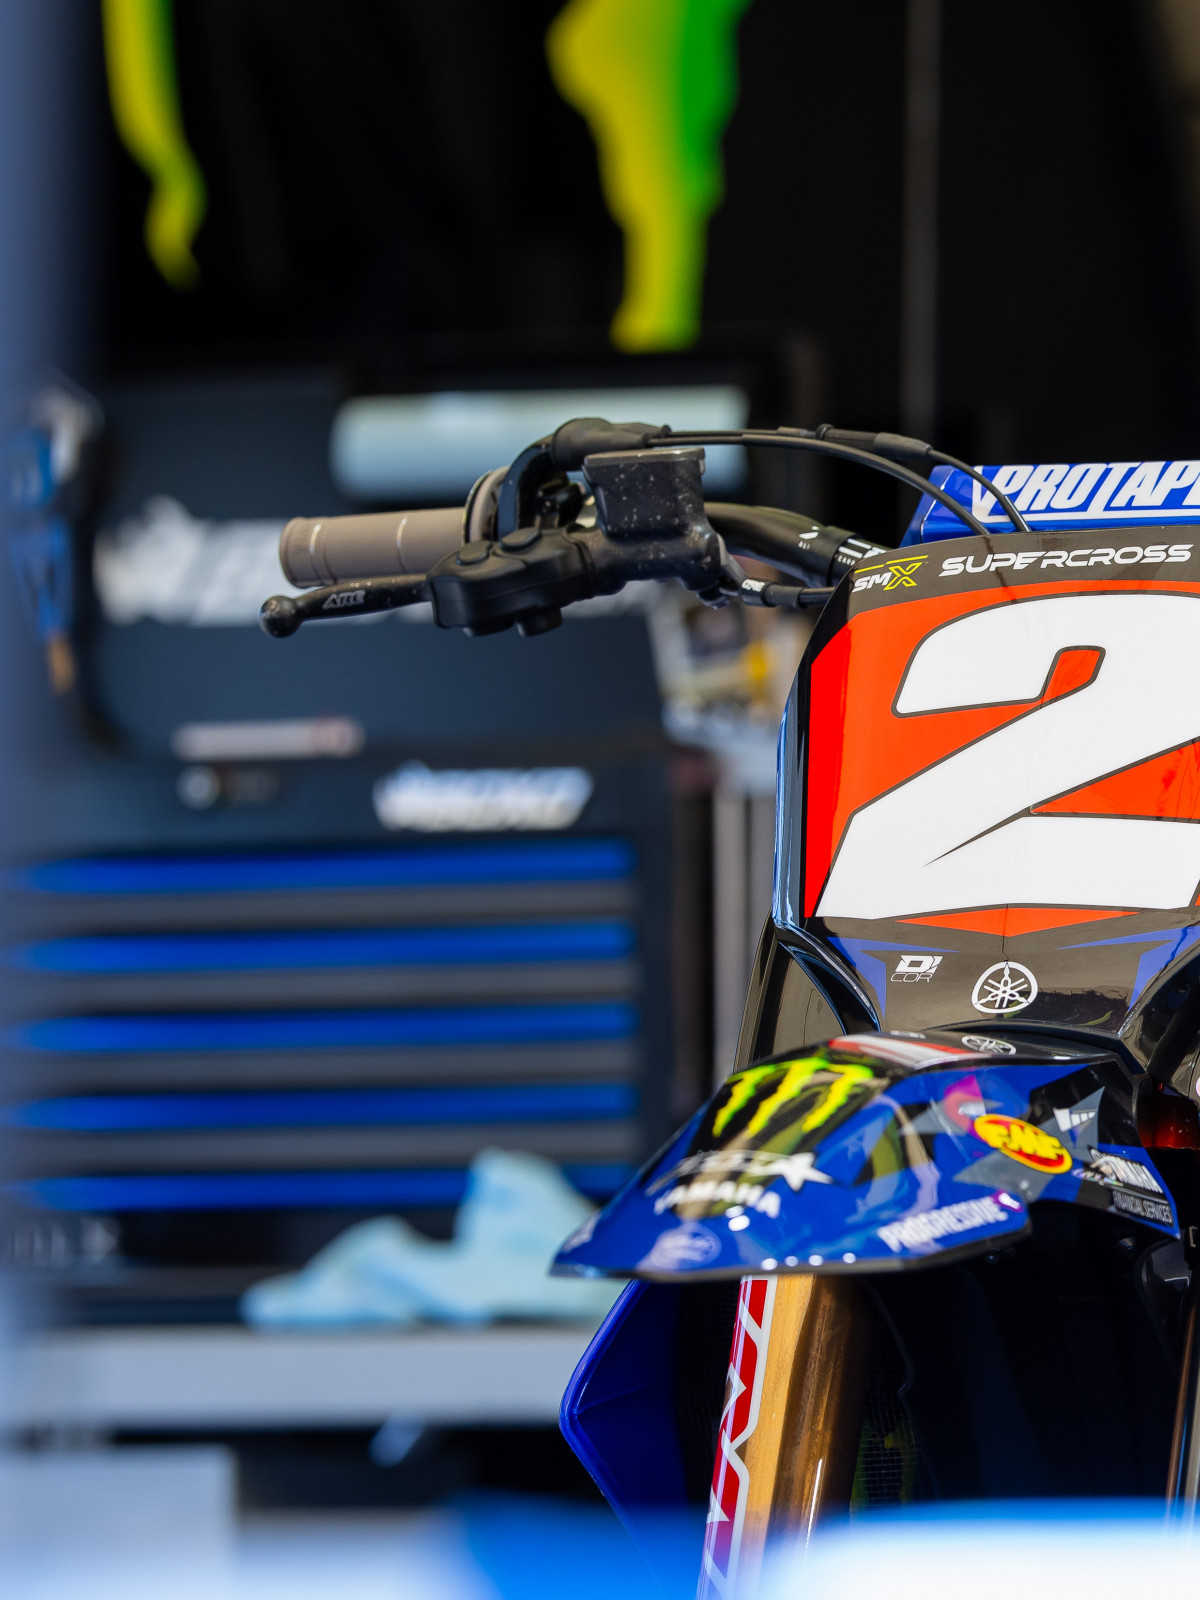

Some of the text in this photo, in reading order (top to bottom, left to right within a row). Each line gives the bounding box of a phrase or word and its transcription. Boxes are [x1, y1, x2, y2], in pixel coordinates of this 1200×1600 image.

[938, 544, 1194, 577] SUPERCROSS
[852, 562, 923, 593] SMX
[976, 1115, 1068, 1162] FMF
[877, 1196, 1009, 1253] PROGRESSIVE
[1142, 1199, 1173, 1223] SERVICES
